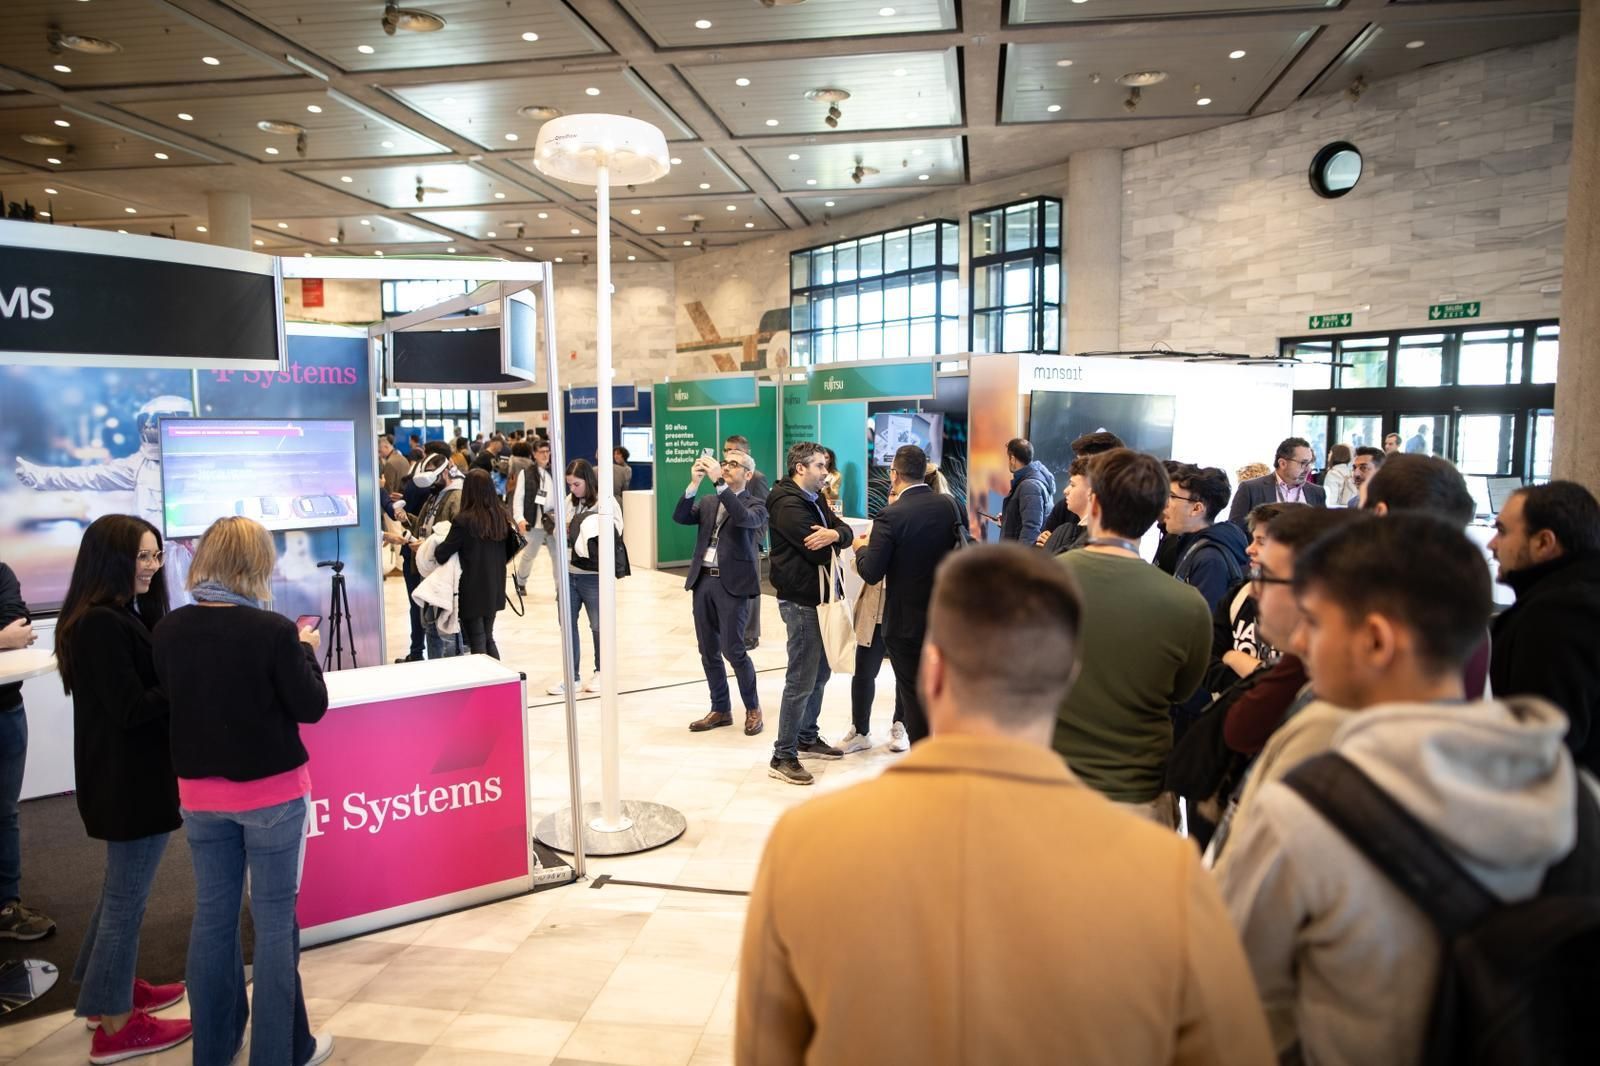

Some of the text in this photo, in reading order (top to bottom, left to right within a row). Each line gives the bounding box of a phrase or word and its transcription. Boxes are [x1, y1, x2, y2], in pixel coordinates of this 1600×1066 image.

[823, 375, 844, 393] FUJITSU
[674, 387, 689, 403] FUJITSU
[674, 448, 695, 456] España
[342, 776, 503, 834] Systems
